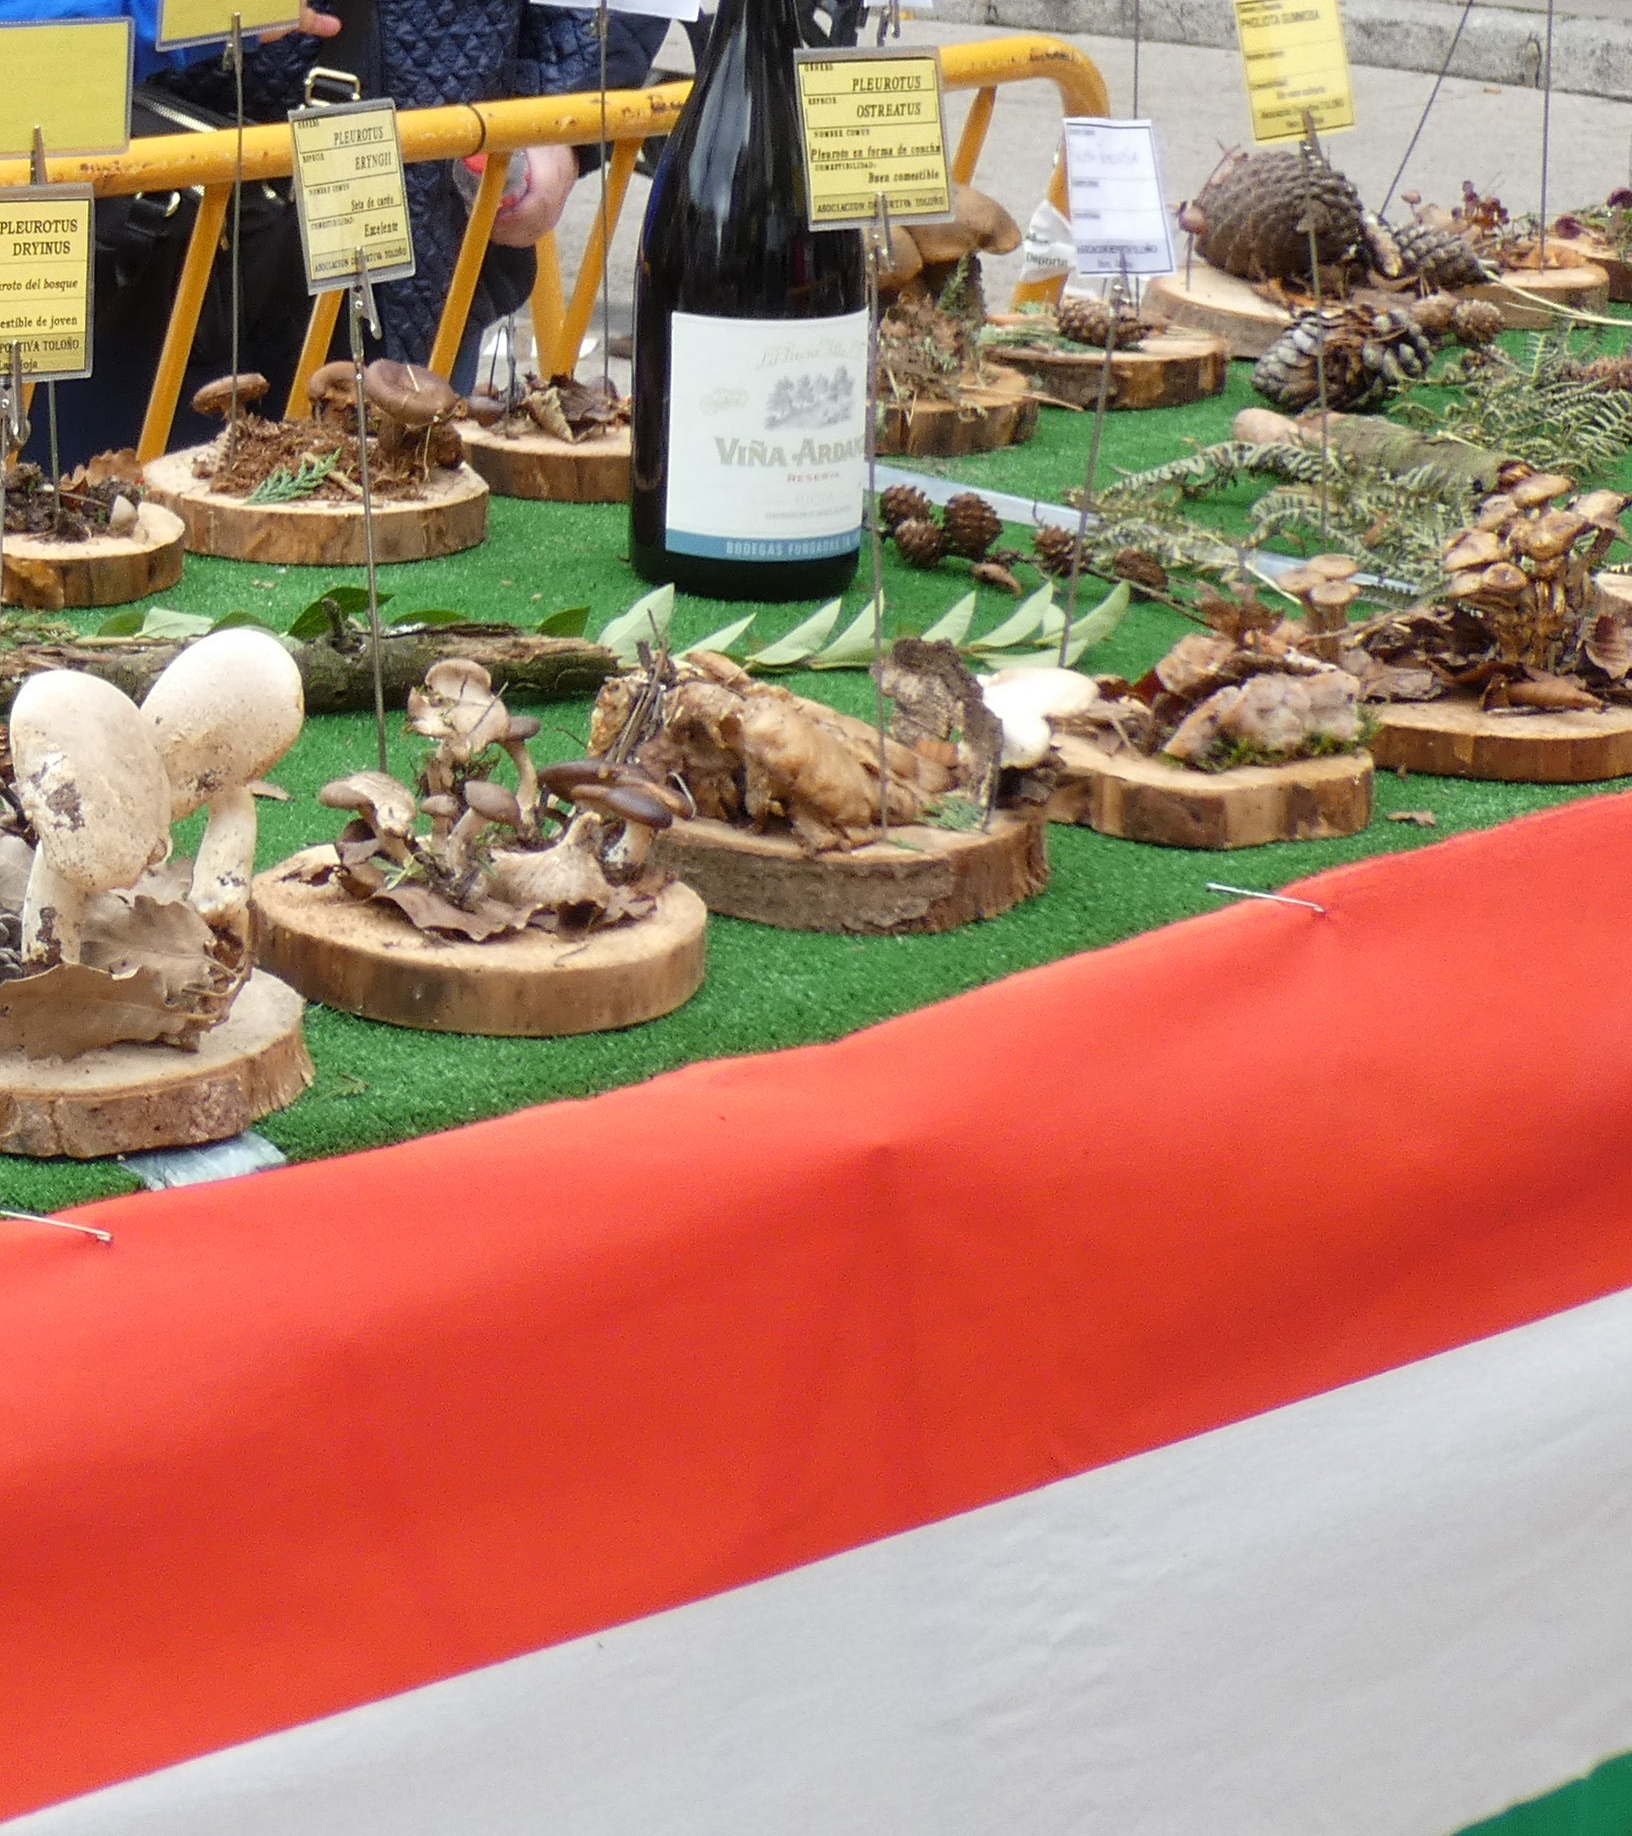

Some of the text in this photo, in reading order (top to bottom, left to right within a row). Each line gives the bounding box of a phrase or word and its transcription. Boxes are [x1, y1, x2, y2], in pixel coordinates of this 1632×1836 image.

[852, 76, 921, 92] PLEUROTUS
[857, 102, 921, 118] OSTREATUS
[334, 126, 383, 146] PLEUROTUS
[355, 152, 392, 171] ERYNGII
[0, 219, 78, 235] PLEUROTUS
[13, 241, 71, 256] DRYINUS
[25, 279, 40, 290] del
[44, 278, 78, 292] bosque
[36, 316, 47, 326] de
[50, 315, 78, 329] joven
[725, 540, 783, 555] BODEGAS
